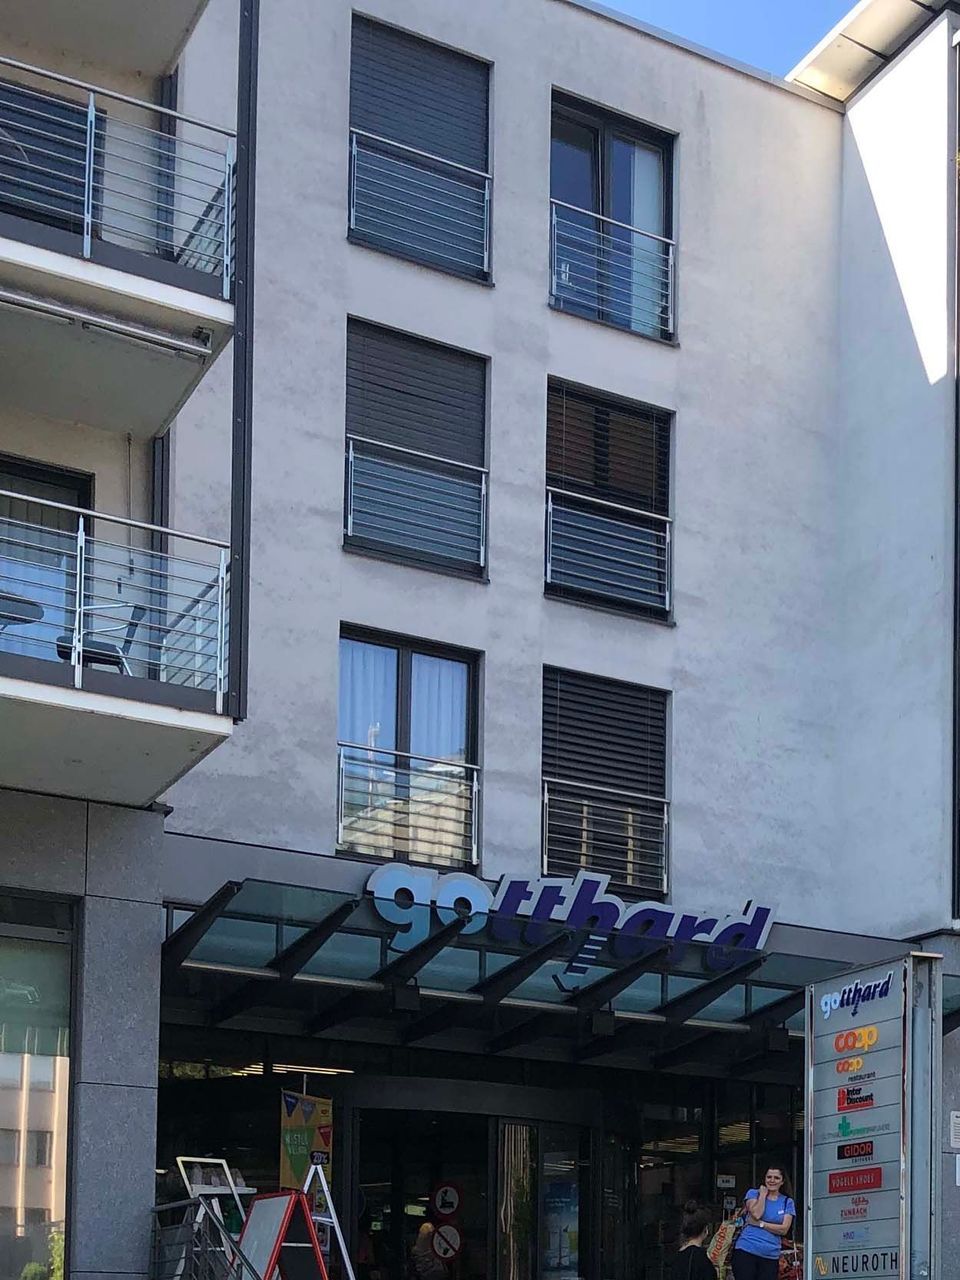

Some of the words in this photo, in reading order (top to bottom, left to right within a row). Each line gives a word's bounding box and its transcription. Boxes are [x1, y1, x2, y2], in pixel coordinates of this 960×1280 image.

[366, 863, 779, 972] gotthard
[820, 971, 893, 1019] gotthard
[834, 1026, 878, 1052] coop
[836, 1056, 863, 1074] coop
[847, 1092, 874, 1105] Discount
[844, 1142, 872, 1157] GIDOR
[832, 1252, 898, 1274] NEUROTH
